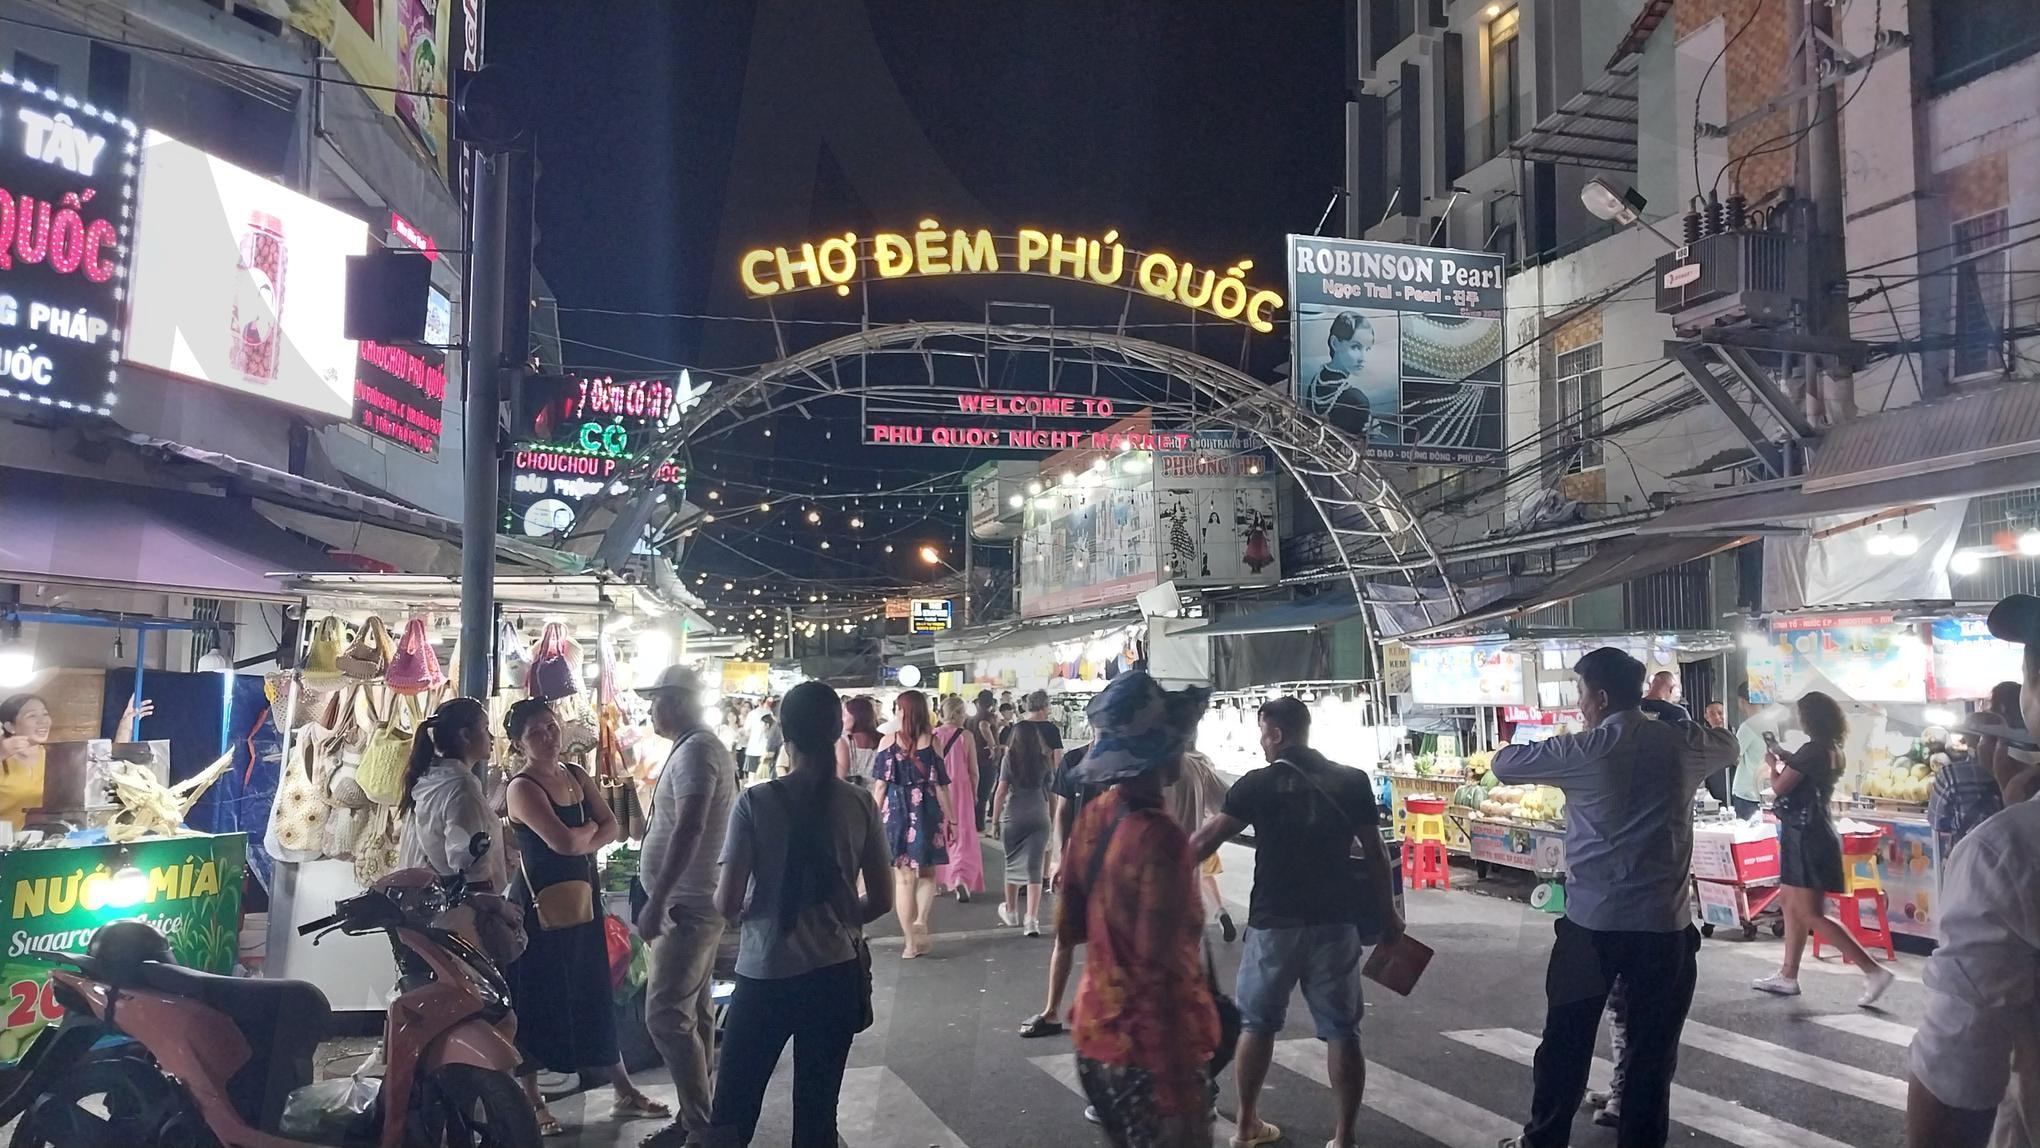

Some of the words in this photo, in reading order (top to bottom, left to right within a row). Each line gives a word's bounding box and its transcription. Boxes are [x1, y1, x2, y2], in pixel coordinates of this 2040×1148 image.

[18, 108, 106, 177] TÂY
[741, 232, 858, 297] CHỢ
[873, 218, 1000, 279] ĐÊM
[1018, 229, 1125, 285] PHÚ
[1138, 252, 1284, 334] QUỐC
[1296, 246, 1435, 284] ROBINSON
[1440, 259, 1503, 290] Pearl
[29, 301, 109, 345] PHÁP
[957, 393, 1076, 416] WELCOME
[1082, 398, 1114, 417] TO
[873, 424, 924, 446] PHU
[931, 426, 1000, 448] QUOC
[1008, 429, 1083, 450] NIGHT
[1090, 430, 1192, 453] MARKET
[515, 450, 599, 476] CHOUCHOU
[12, 863, 135, 920] NƯỚ
[146, 855, 220, 904] MÍA
[8, 929, 98, 957] Sugarc
